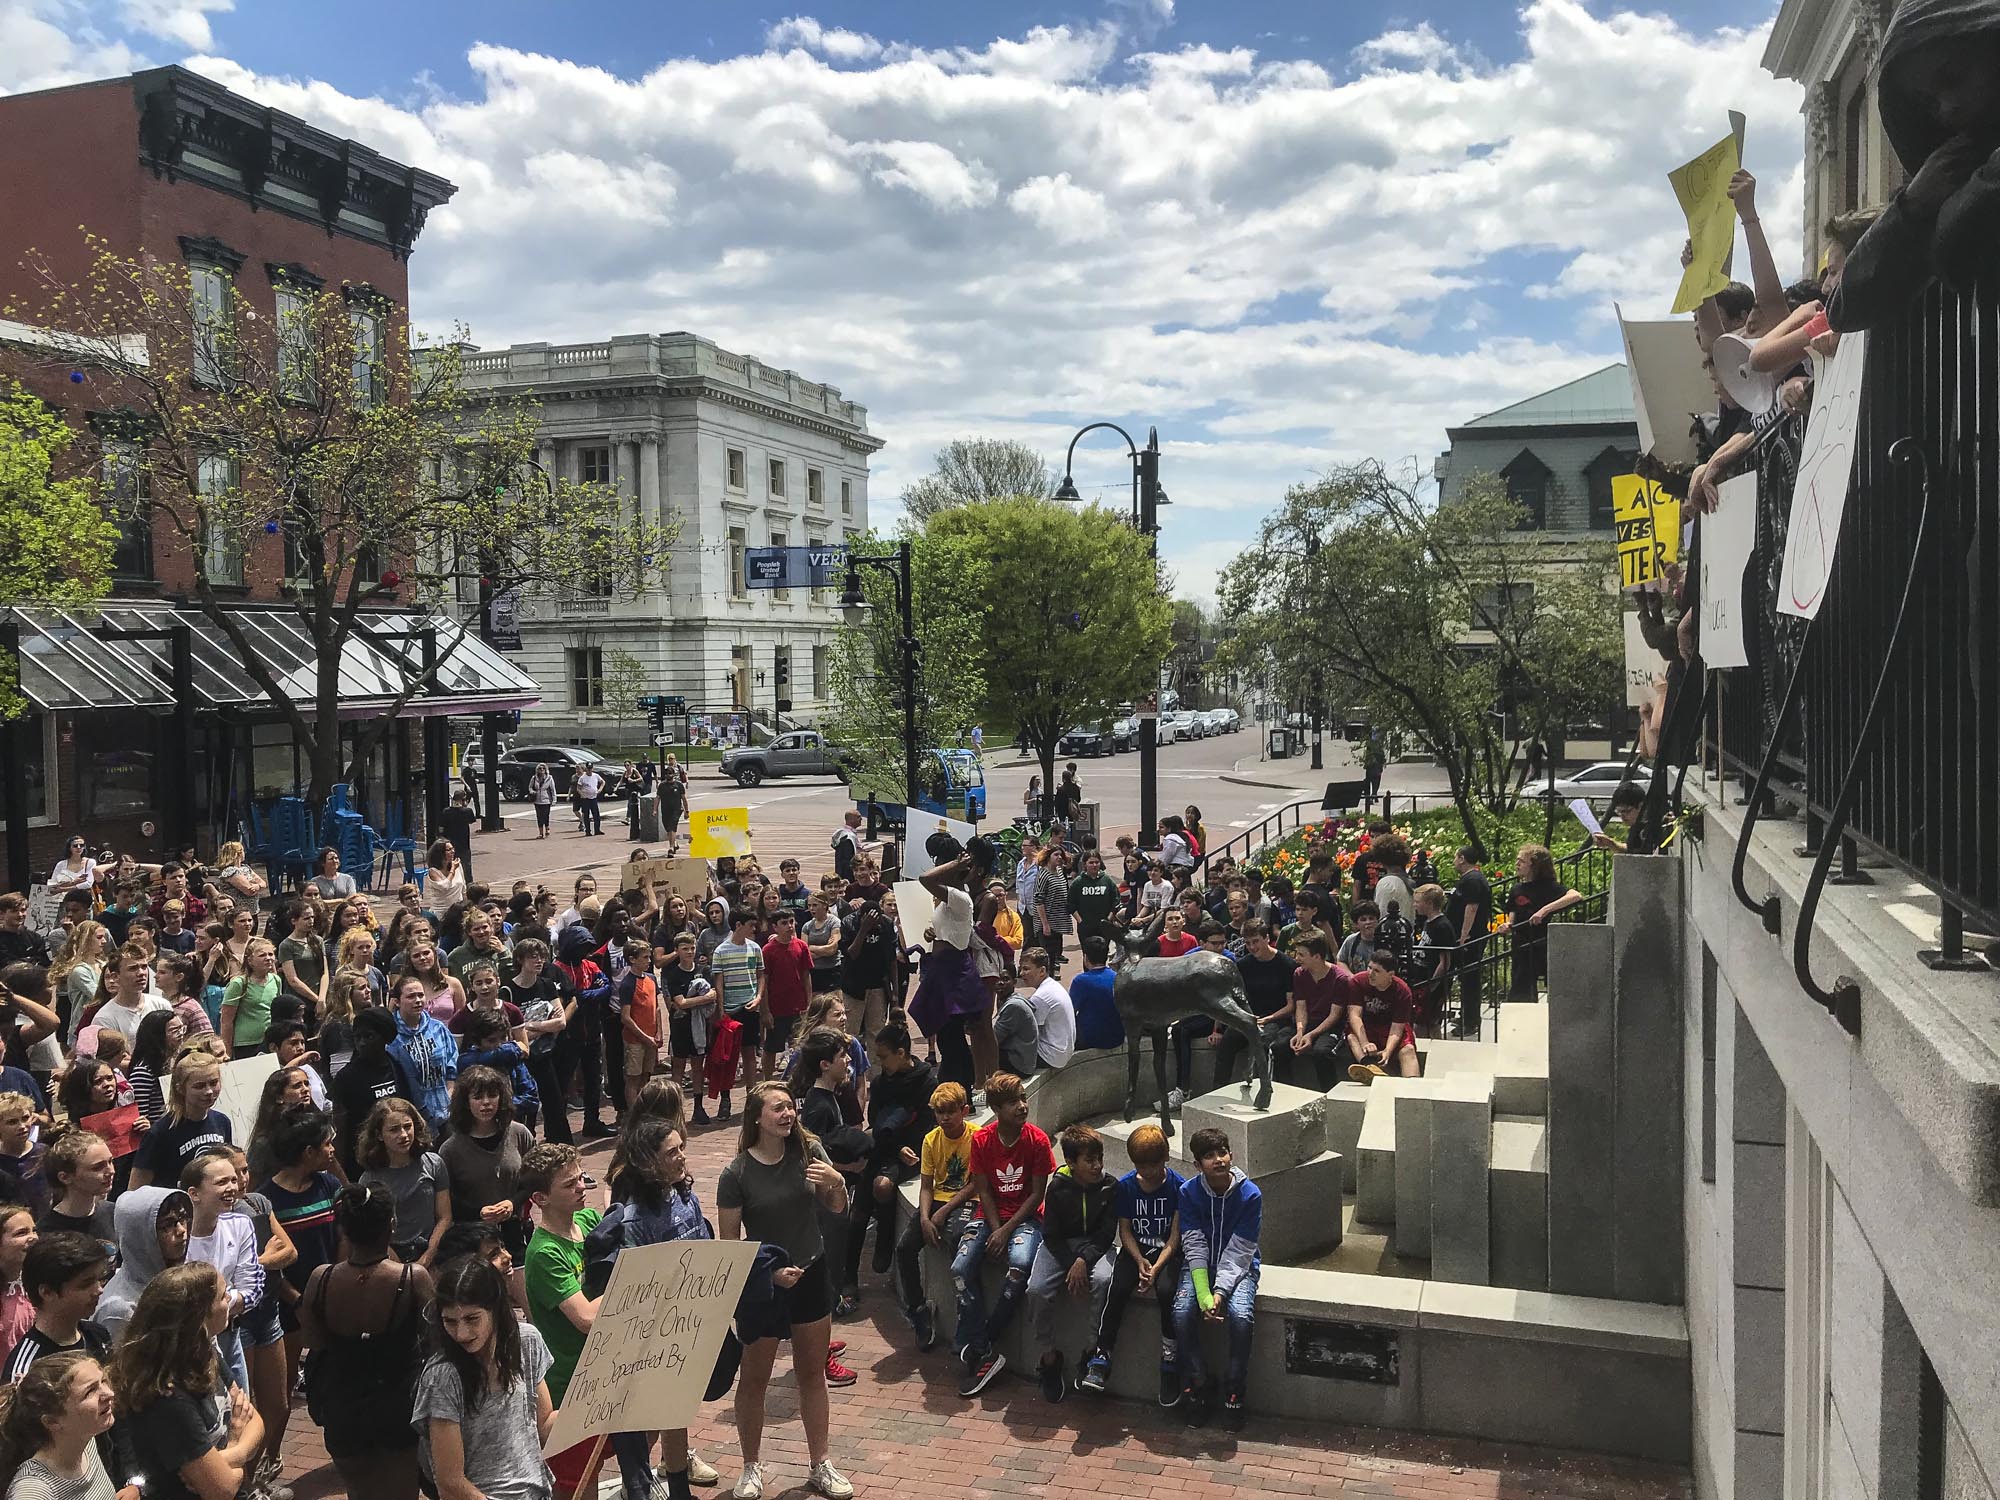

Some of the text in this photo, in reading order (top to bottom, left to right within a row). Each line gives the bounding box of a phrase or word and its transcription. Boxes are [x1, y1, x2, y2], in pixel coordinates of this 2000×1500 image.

[707, 814, 728, 823] BLACK
[179, 1133, 225, 1156] EDMUNDS
[998, 1182, 1024, 1193] adidas
[1136, 1197, 1168, 1216] IN IT
[601, 1248, 733, 1318] Laundry Should
[584, 1305, 702, 1367] Be The Only
[666, 1343, 687, 1376] By
